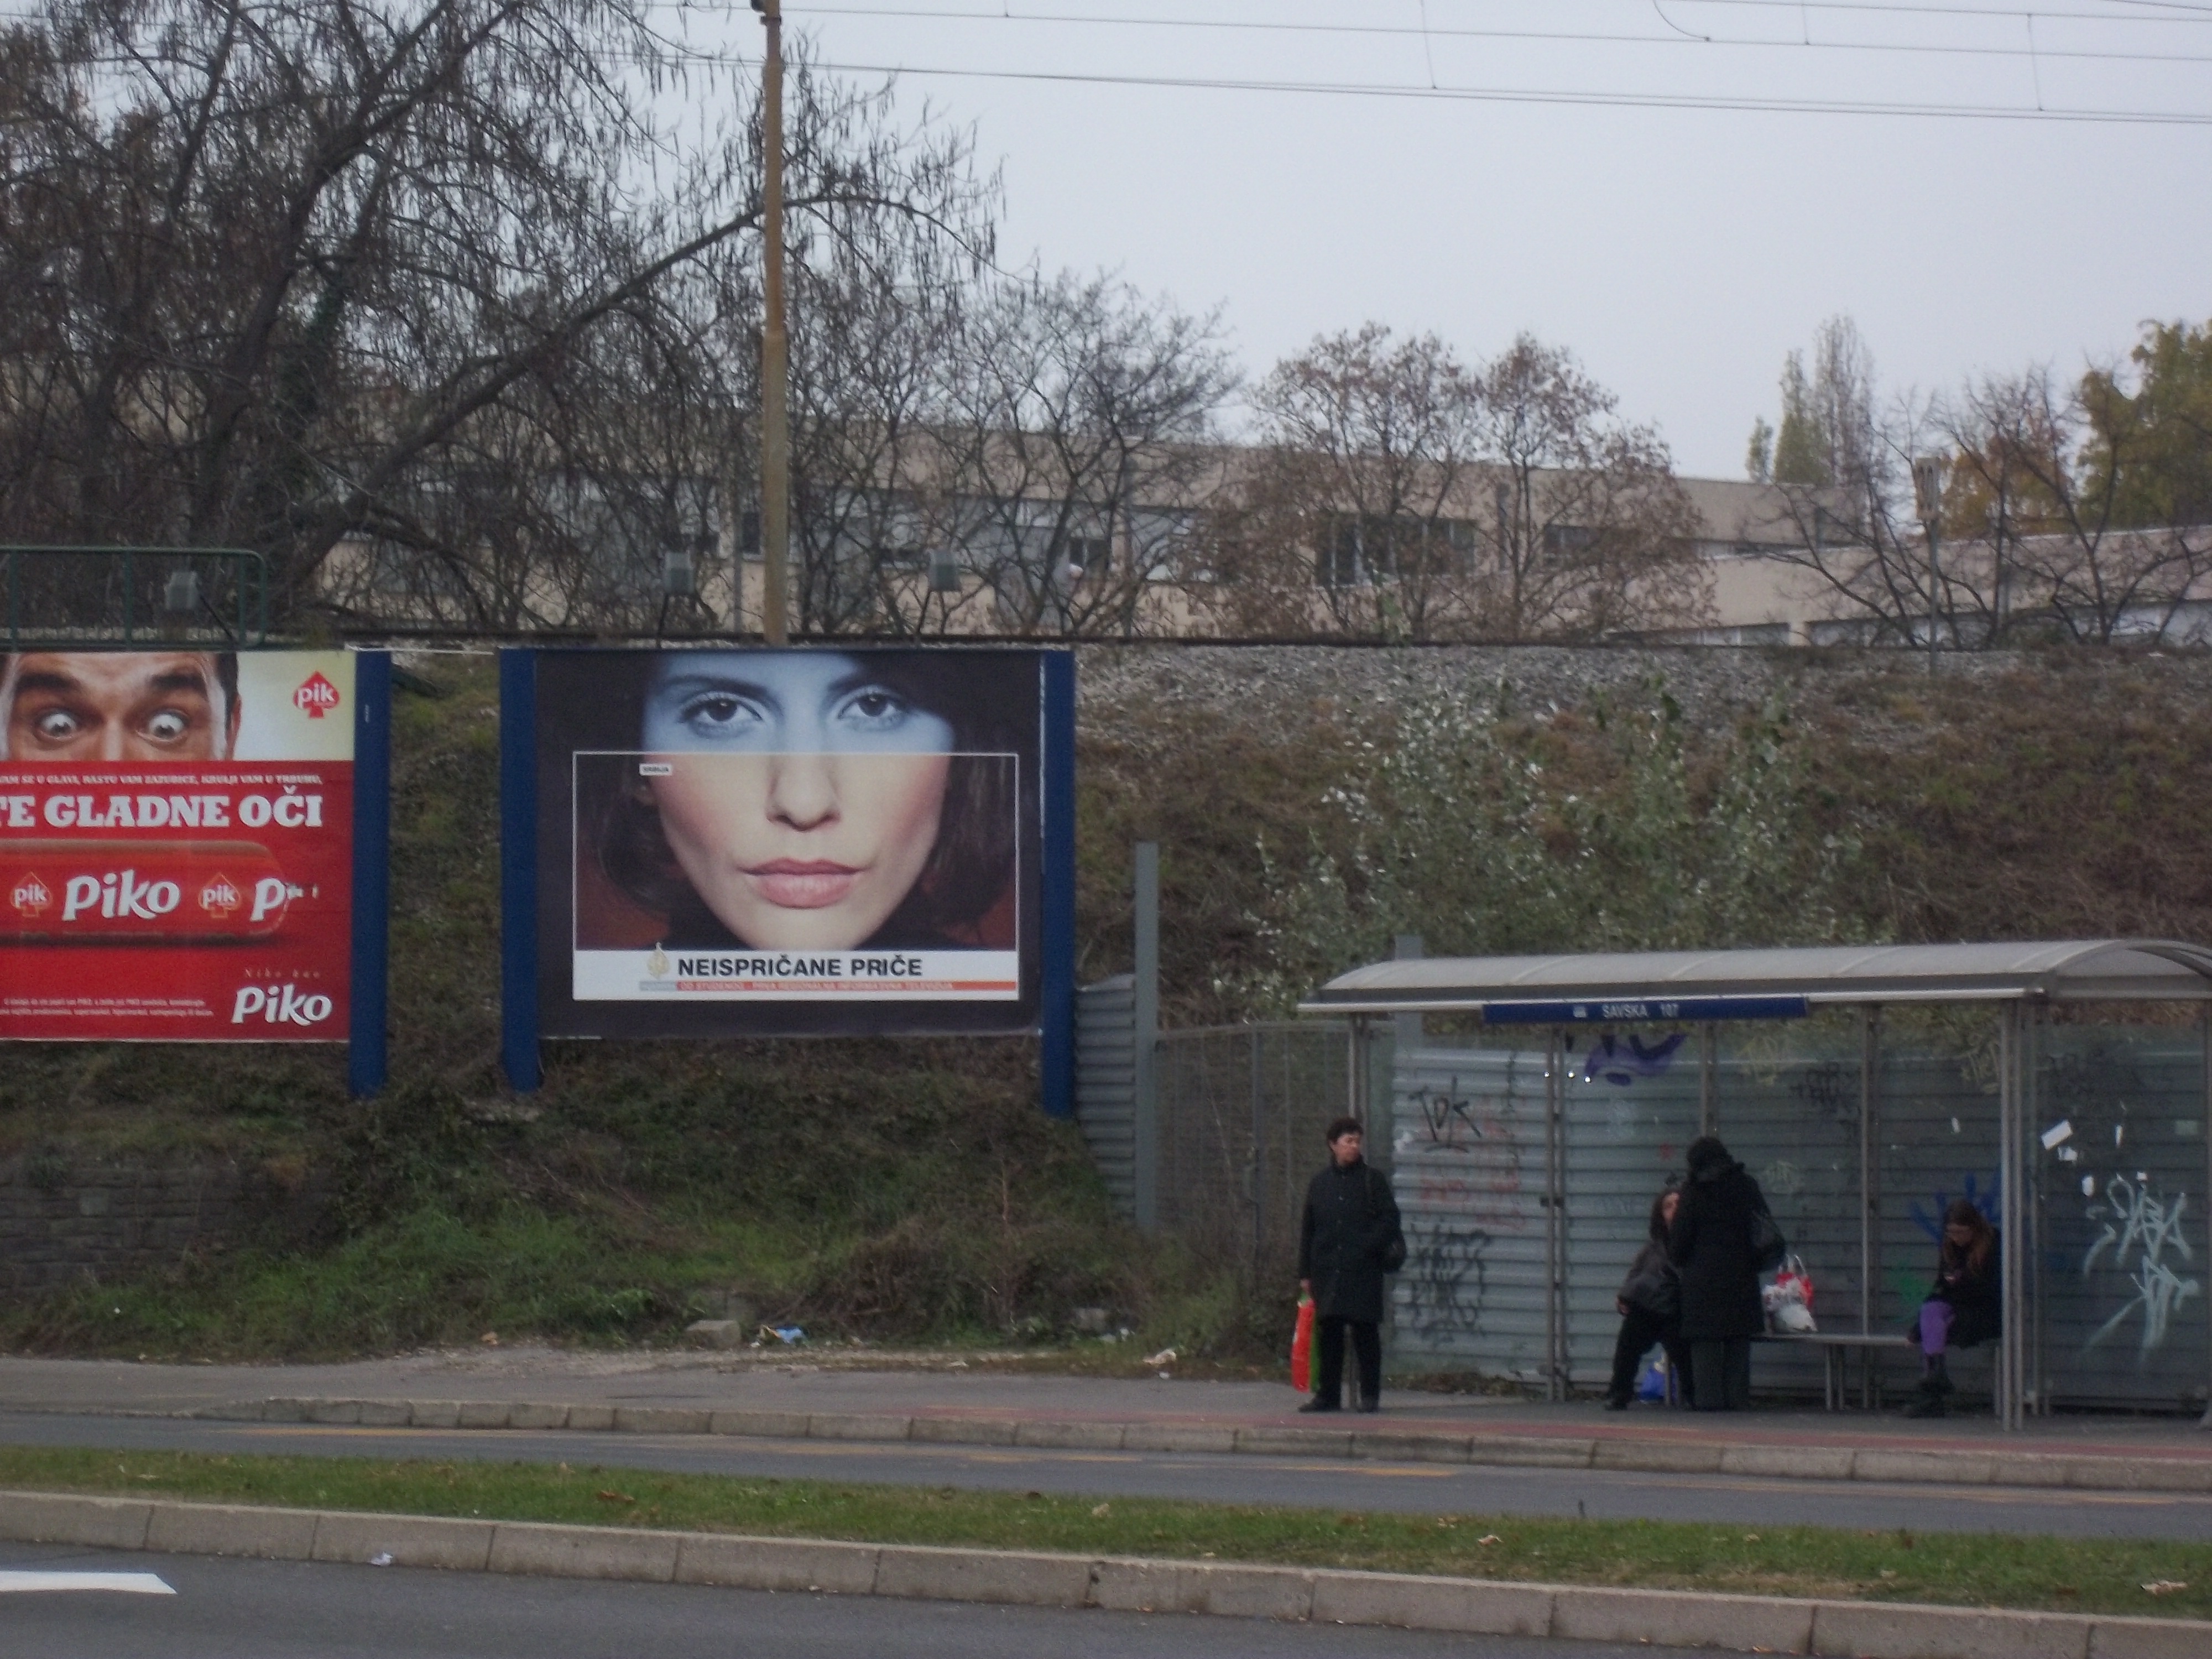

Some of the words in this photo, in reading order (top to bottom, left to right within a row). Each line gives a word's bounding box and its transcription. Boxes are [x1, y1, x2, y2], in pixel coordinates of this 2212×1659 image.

[297, 682, 336, 709] pik
[44, 795, 230, 828] GLADNE
[238, 786, 323, 828] OČI
[14, 884, 48, 909] pik
[62, 869, 181, 921] Piko
[202, 884, 236, 910] pik
[678, 954, 842, 977] NEISPRIČANE
[851, 954, 922, 977] PRIČE
[231, 984, 333, 1026] Piko
